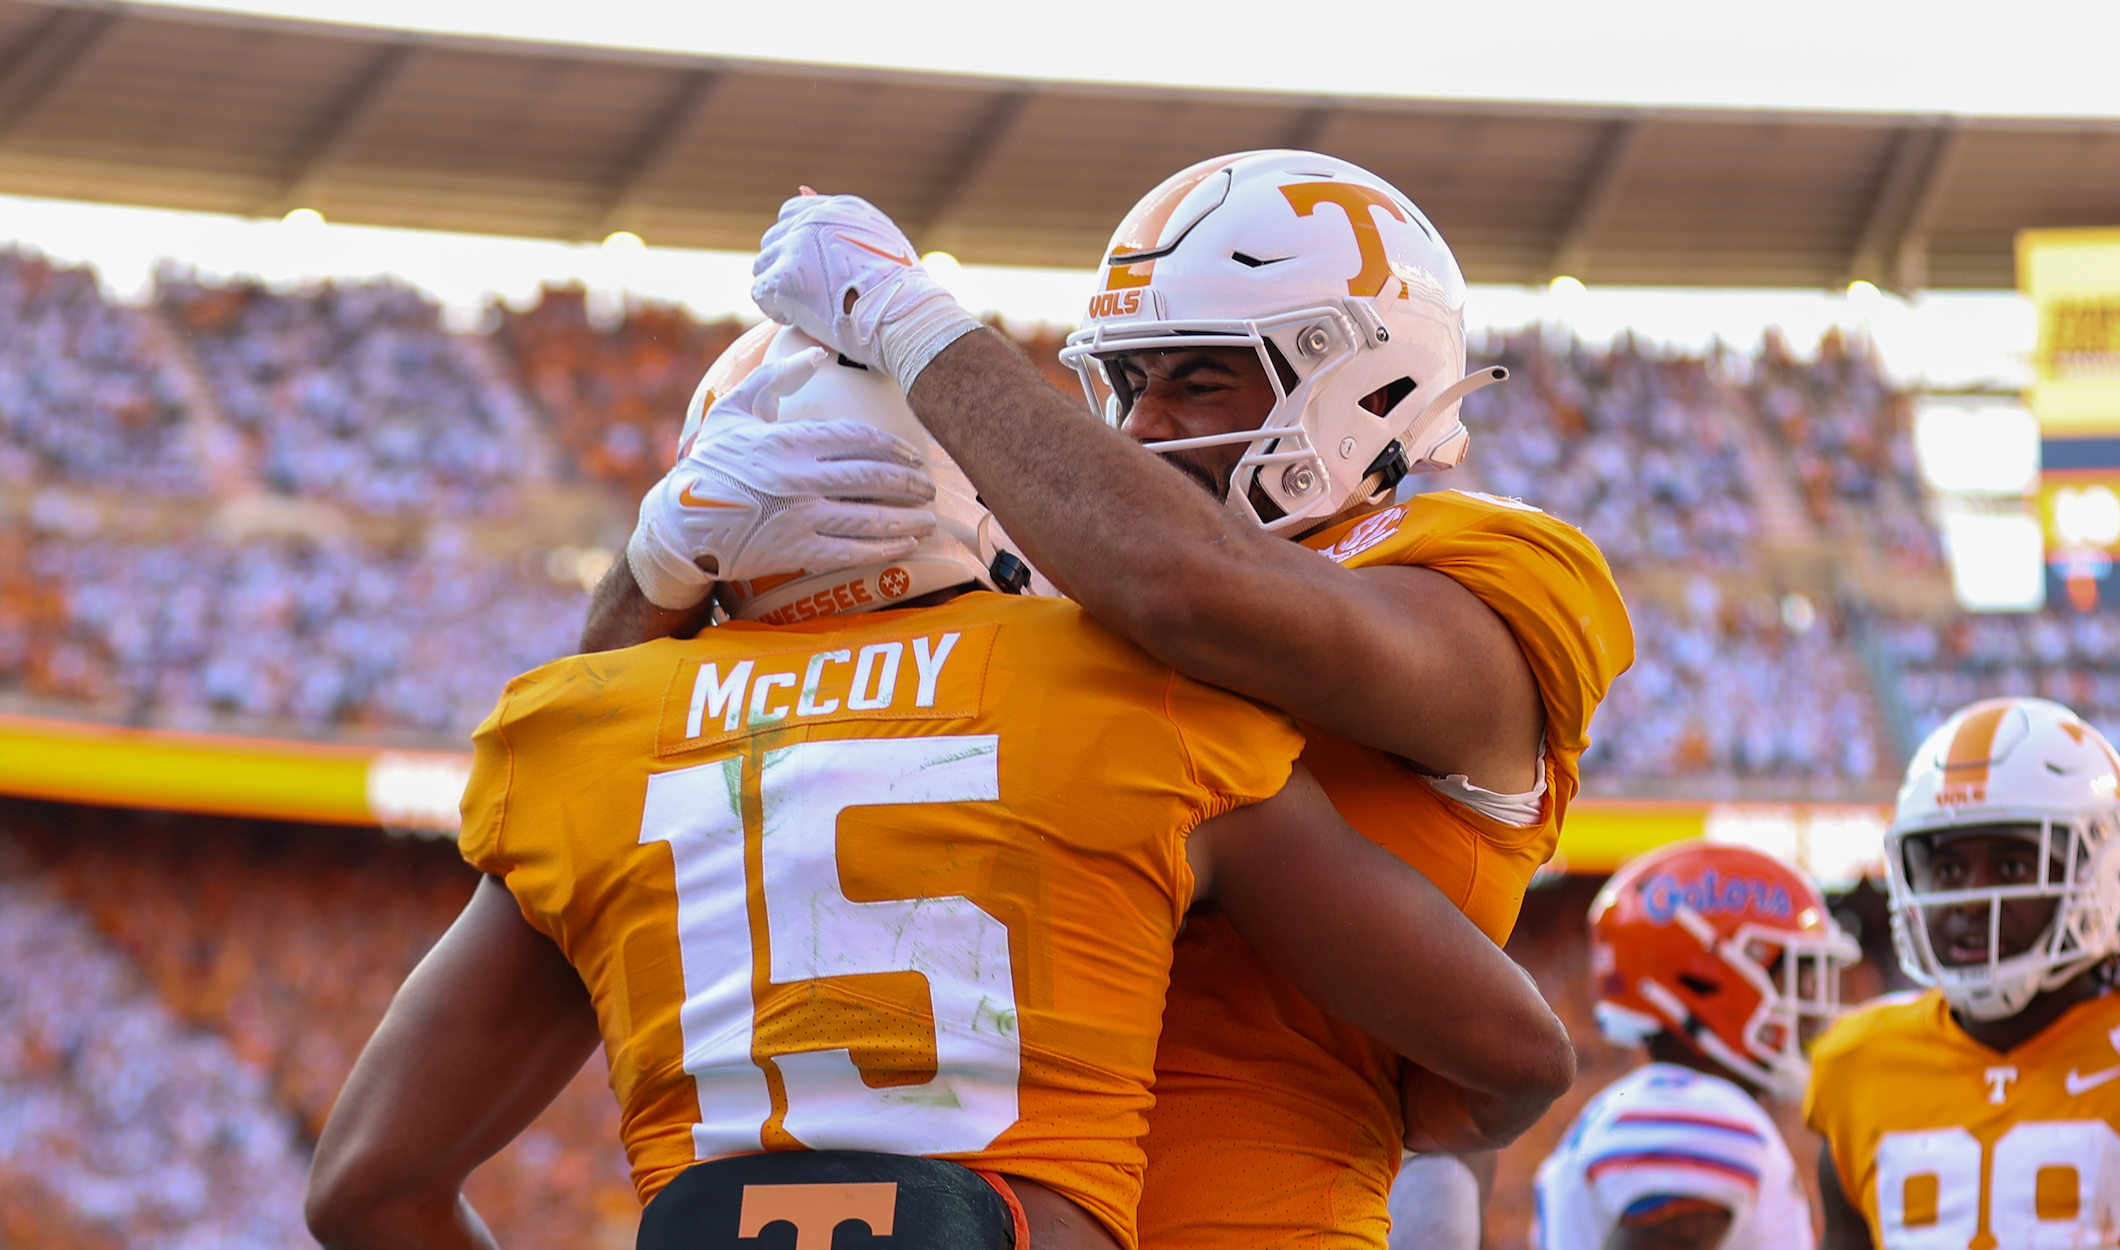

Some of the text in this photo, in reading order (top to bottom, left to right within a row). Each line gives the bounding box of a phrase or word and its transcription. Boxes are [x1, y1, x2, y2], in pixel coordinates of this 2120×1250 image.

[1277, 181, 1409, 300] T
[1088, 289, 1142, 319] VOLS
[685, 632, 961, 739] McCOY
[1642, 865, 1793, 927] Gators
[638, 734, 1020, 1161] 15
[1984, 1065, 2019, 1105] T
